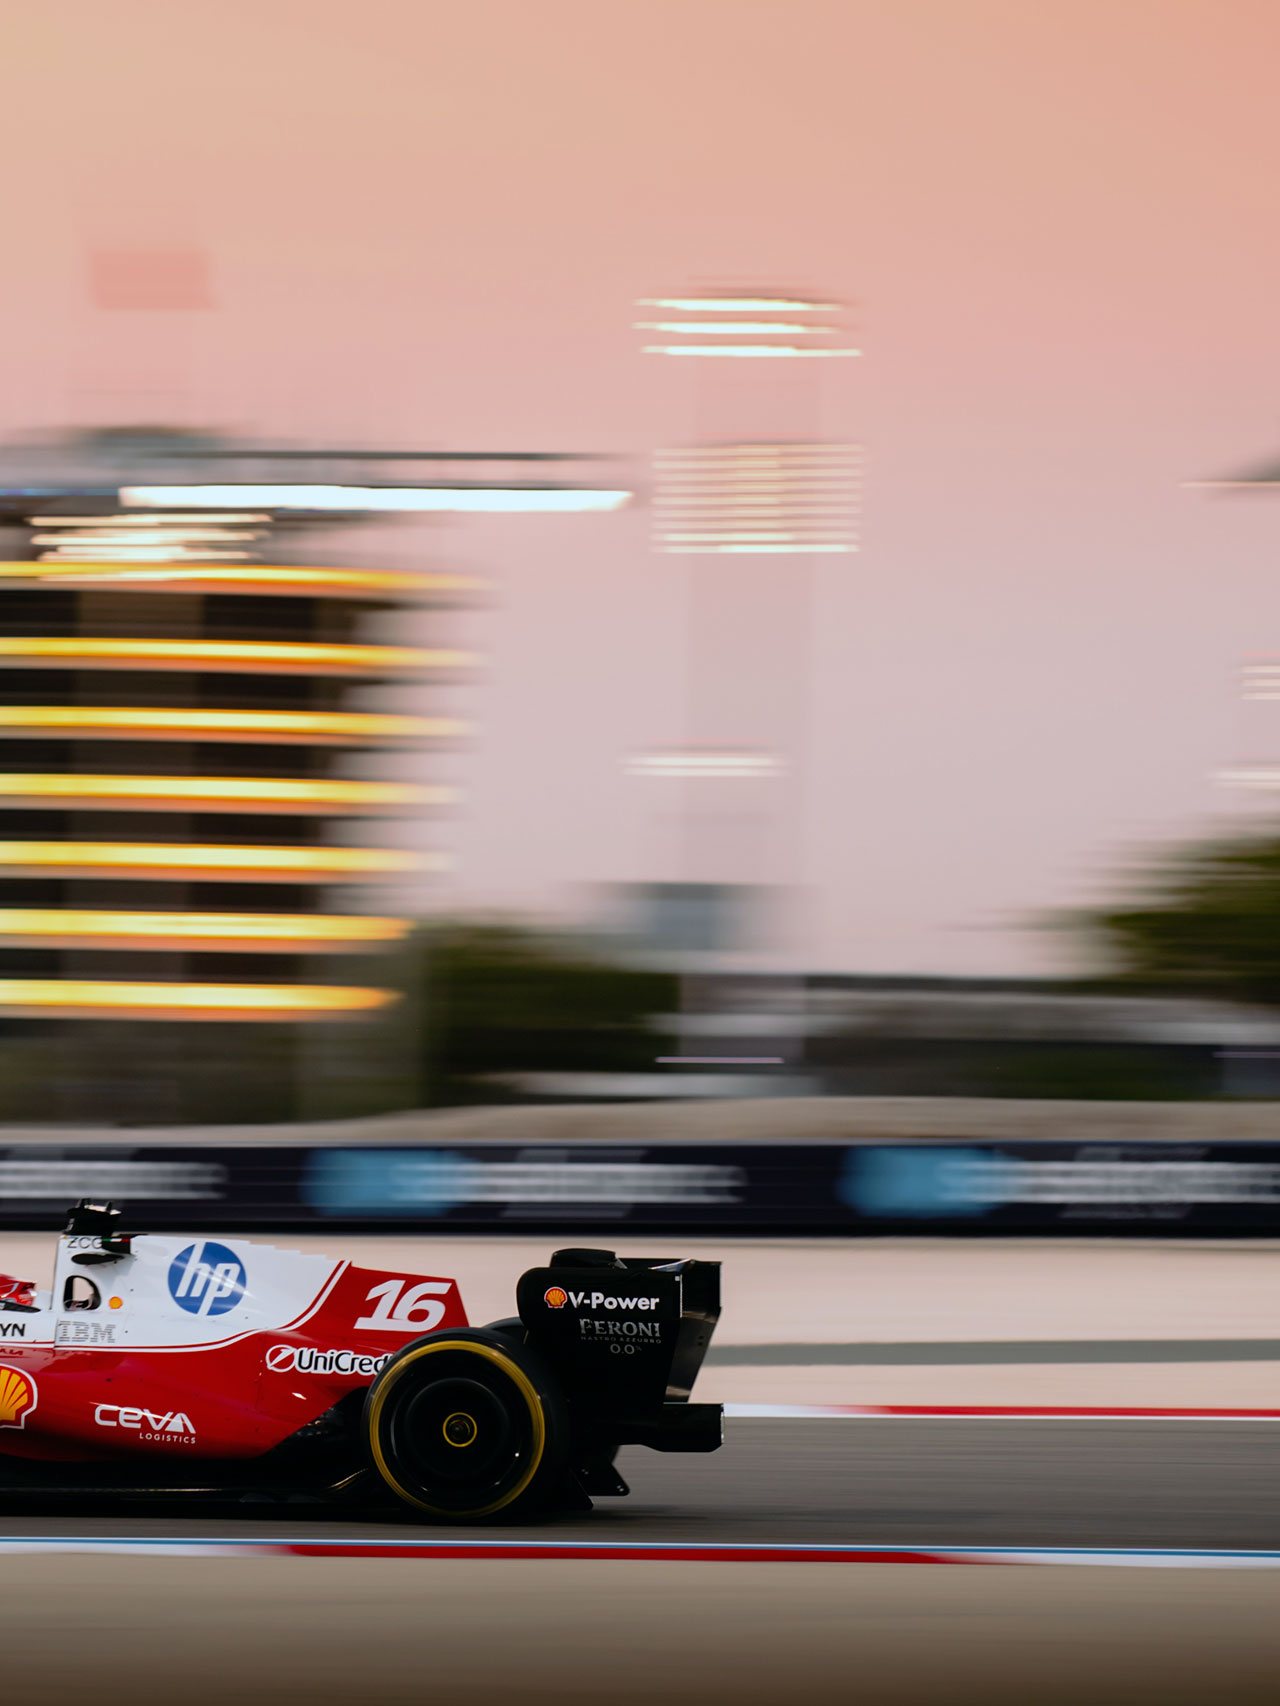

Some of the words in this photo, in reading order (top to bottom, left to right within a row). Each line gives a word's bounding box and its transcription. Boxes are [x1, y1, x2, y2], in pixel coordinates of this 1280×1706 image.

[175, 1242, 241, 1315] hp
[353, 1279, 453, 1332] 16
[568, 1291, 660, 1310] V-Power
[58, 1320, 116, 1343] IBM
[579, 1318, 661, 1337] PERONI
[297, 1350, 392, 1373] UniCred
[139, 1432, 196, 1444] LOGISTICS
